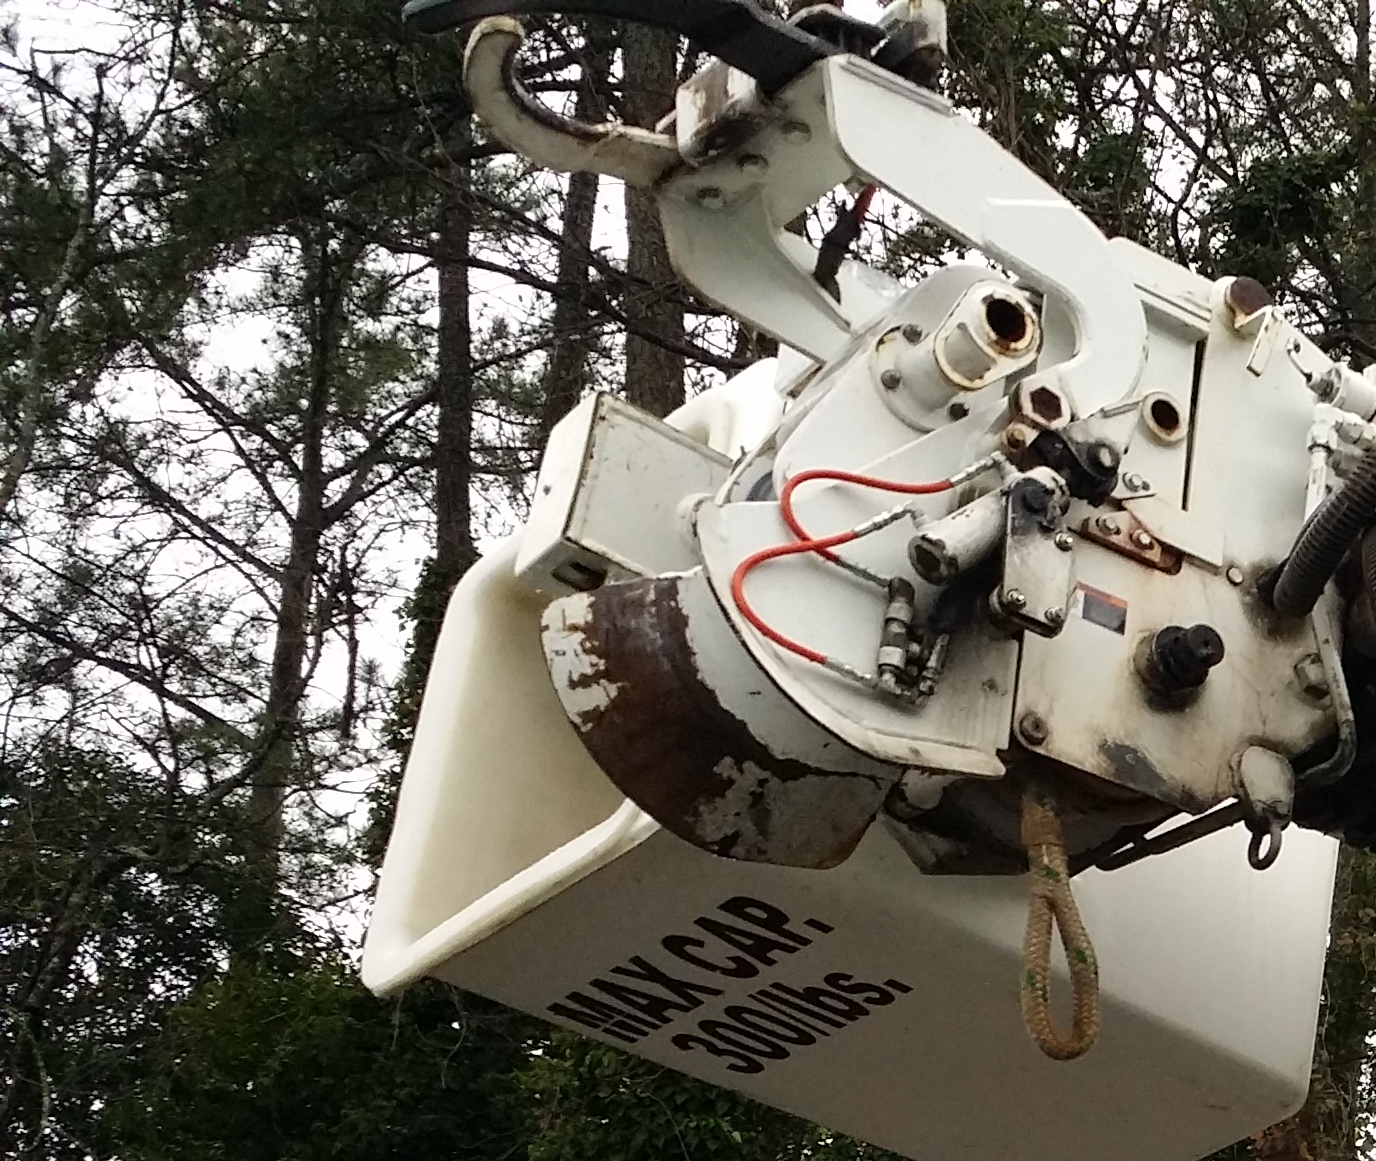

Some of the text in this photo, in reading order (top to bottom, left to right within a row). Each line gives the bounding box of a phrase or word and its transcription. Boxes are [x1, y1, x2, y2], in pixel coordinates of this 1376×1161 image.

[546, 896, 835, 1043] MAX CAP.
[671, 972, 914, 1074] 300/lbs.
